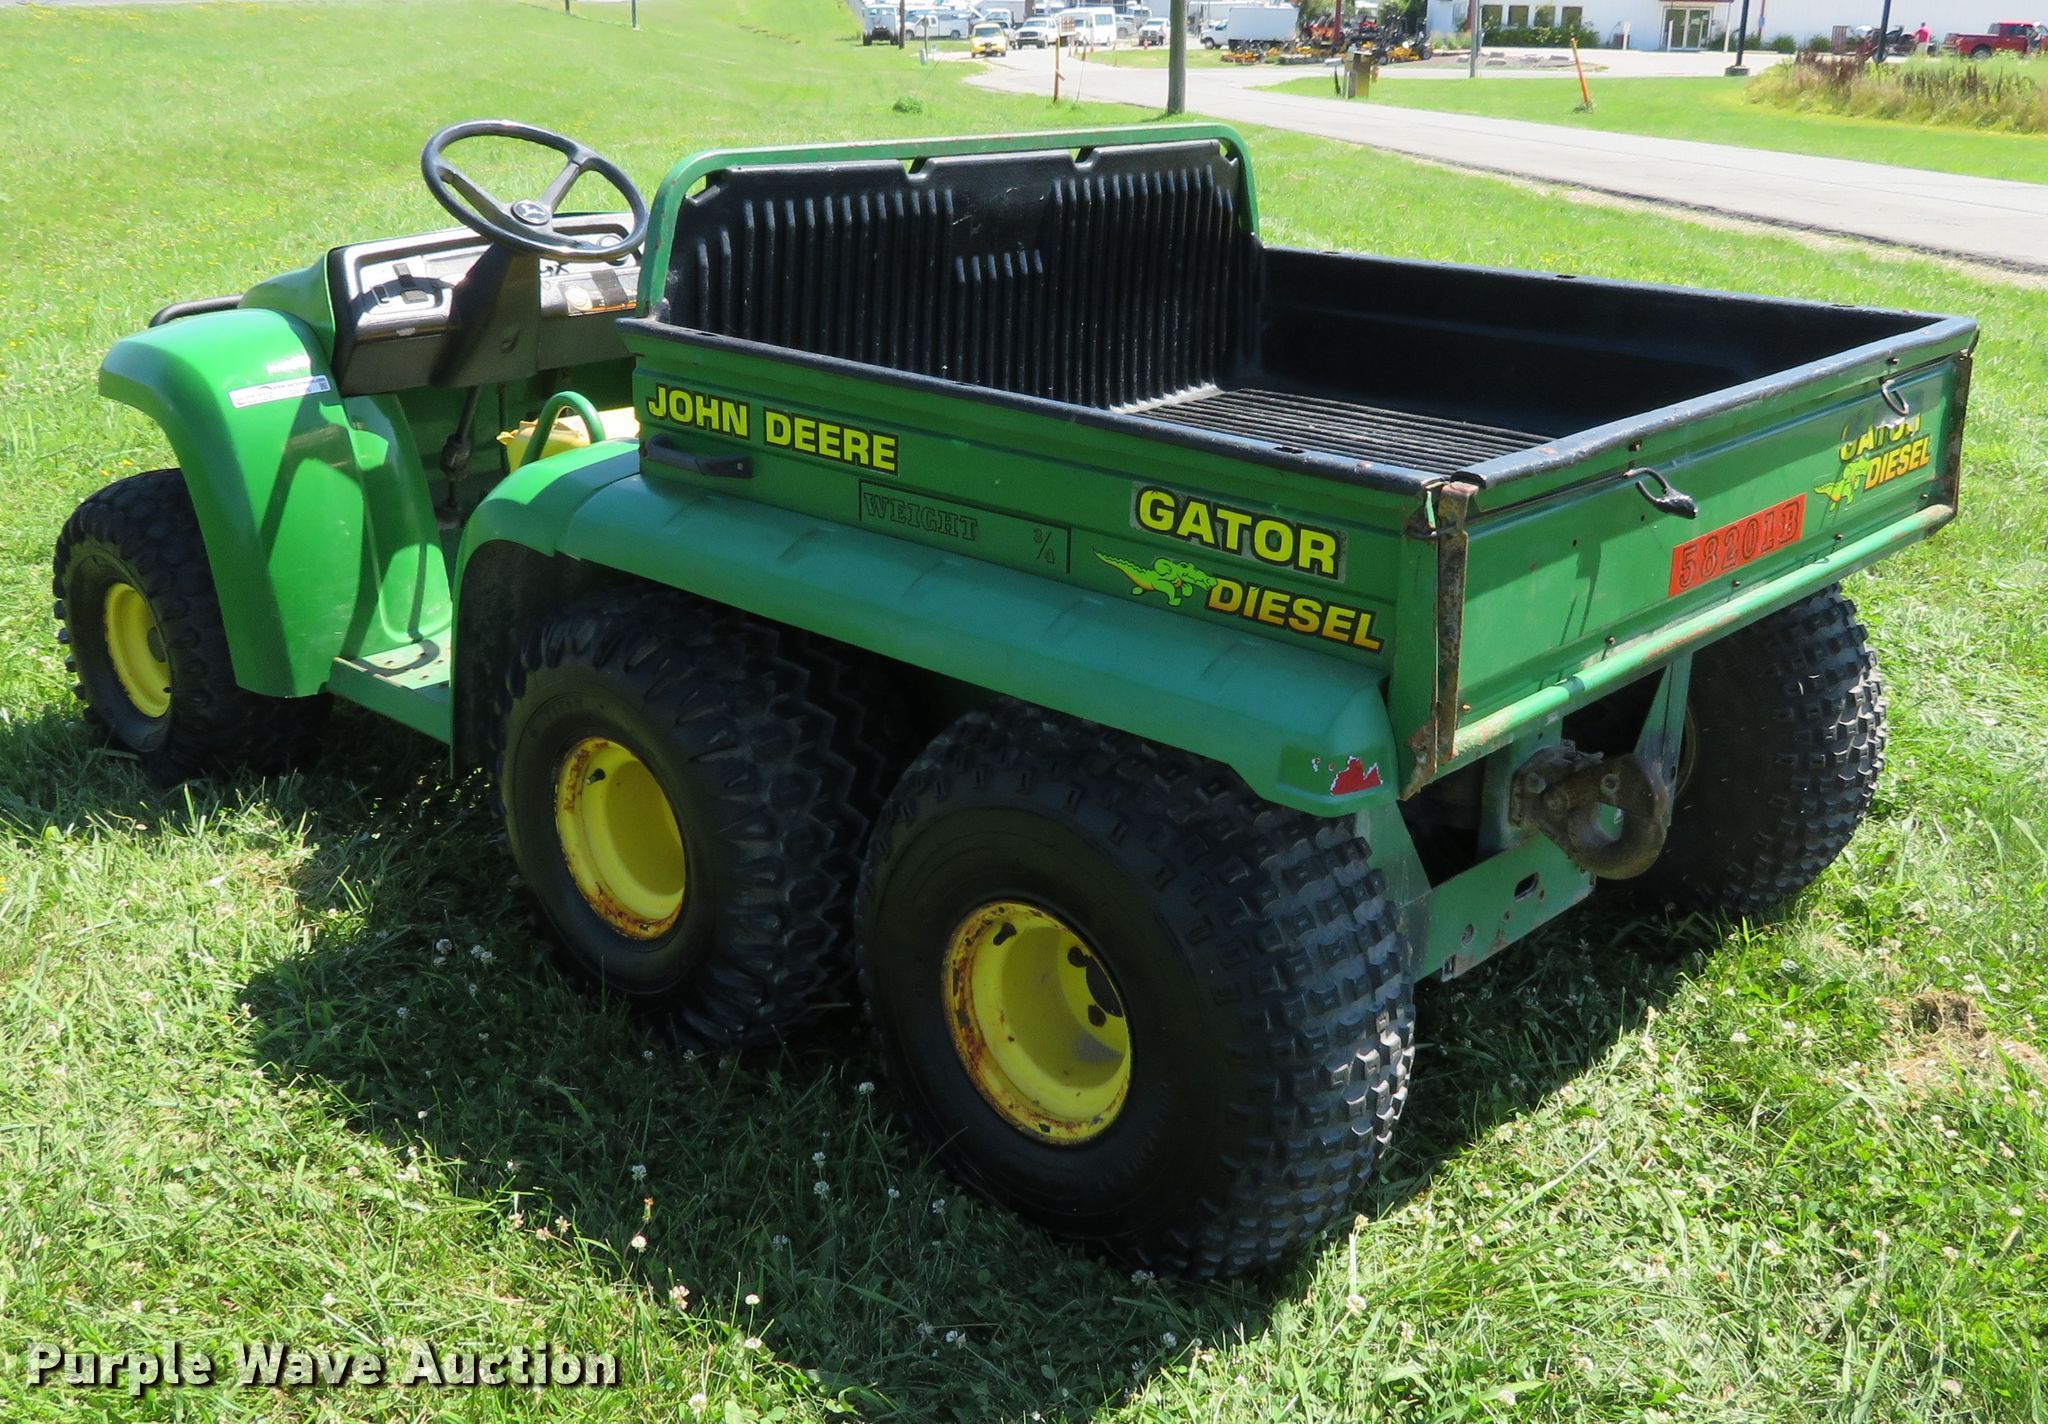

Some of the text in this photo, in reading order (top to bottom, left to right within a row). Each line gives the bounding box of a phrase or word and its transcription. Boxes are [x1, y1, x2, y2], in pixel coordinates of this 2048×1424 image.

[647, 385, 897, 472] JOHN DEERE
[1864, 436, 1931, 491] DIESEL
[863, 492, 979, 542] WEIGHT
[1138, 489, 1337, 575] GATOR
[1679, 500, 1800, 589] 58201B
[1207, 577, 1382, 651] DIESEL
